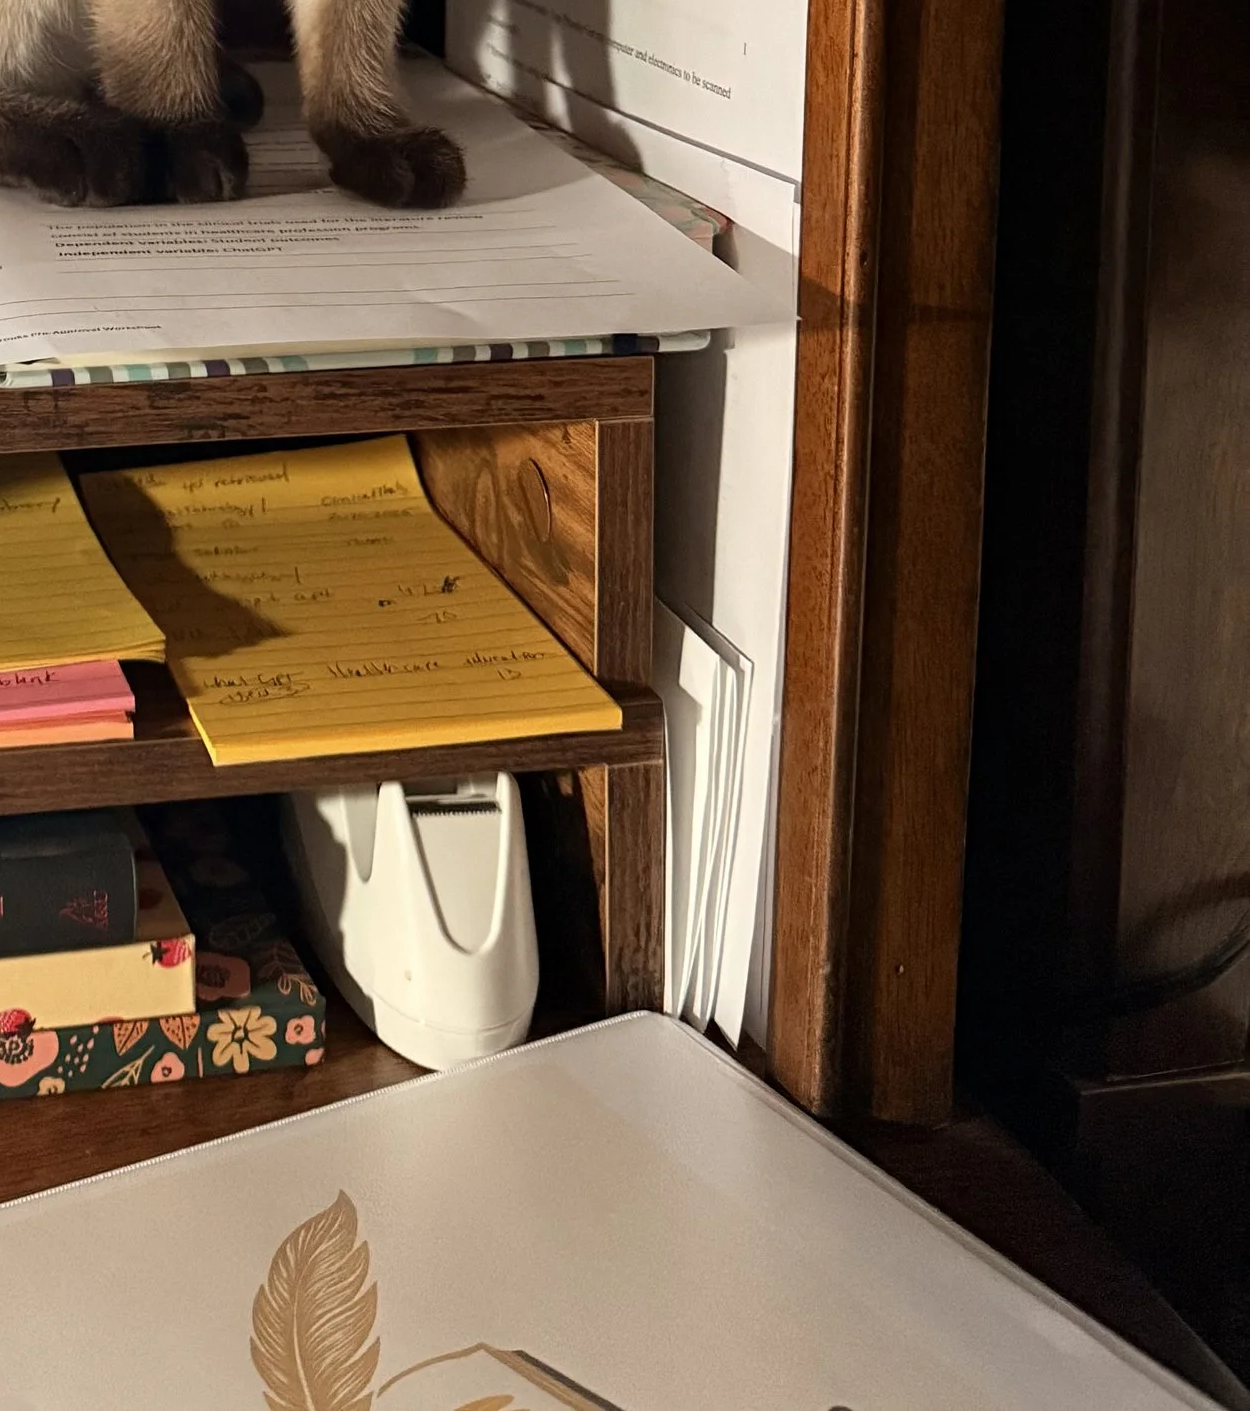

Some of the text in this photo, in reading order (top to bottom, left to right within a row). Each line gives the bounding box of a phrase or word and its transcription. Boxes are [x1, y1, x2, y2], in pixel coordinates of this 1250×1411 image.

[683, 69, 691, 82] to
[691, 71, 701, 86] be
[702, 79, 732, 100] scanned
[54, 240, 134, 248] Dependent
[58, 249, 151, 258] Independent
[222, 246, 283, 254] ChatGPT
